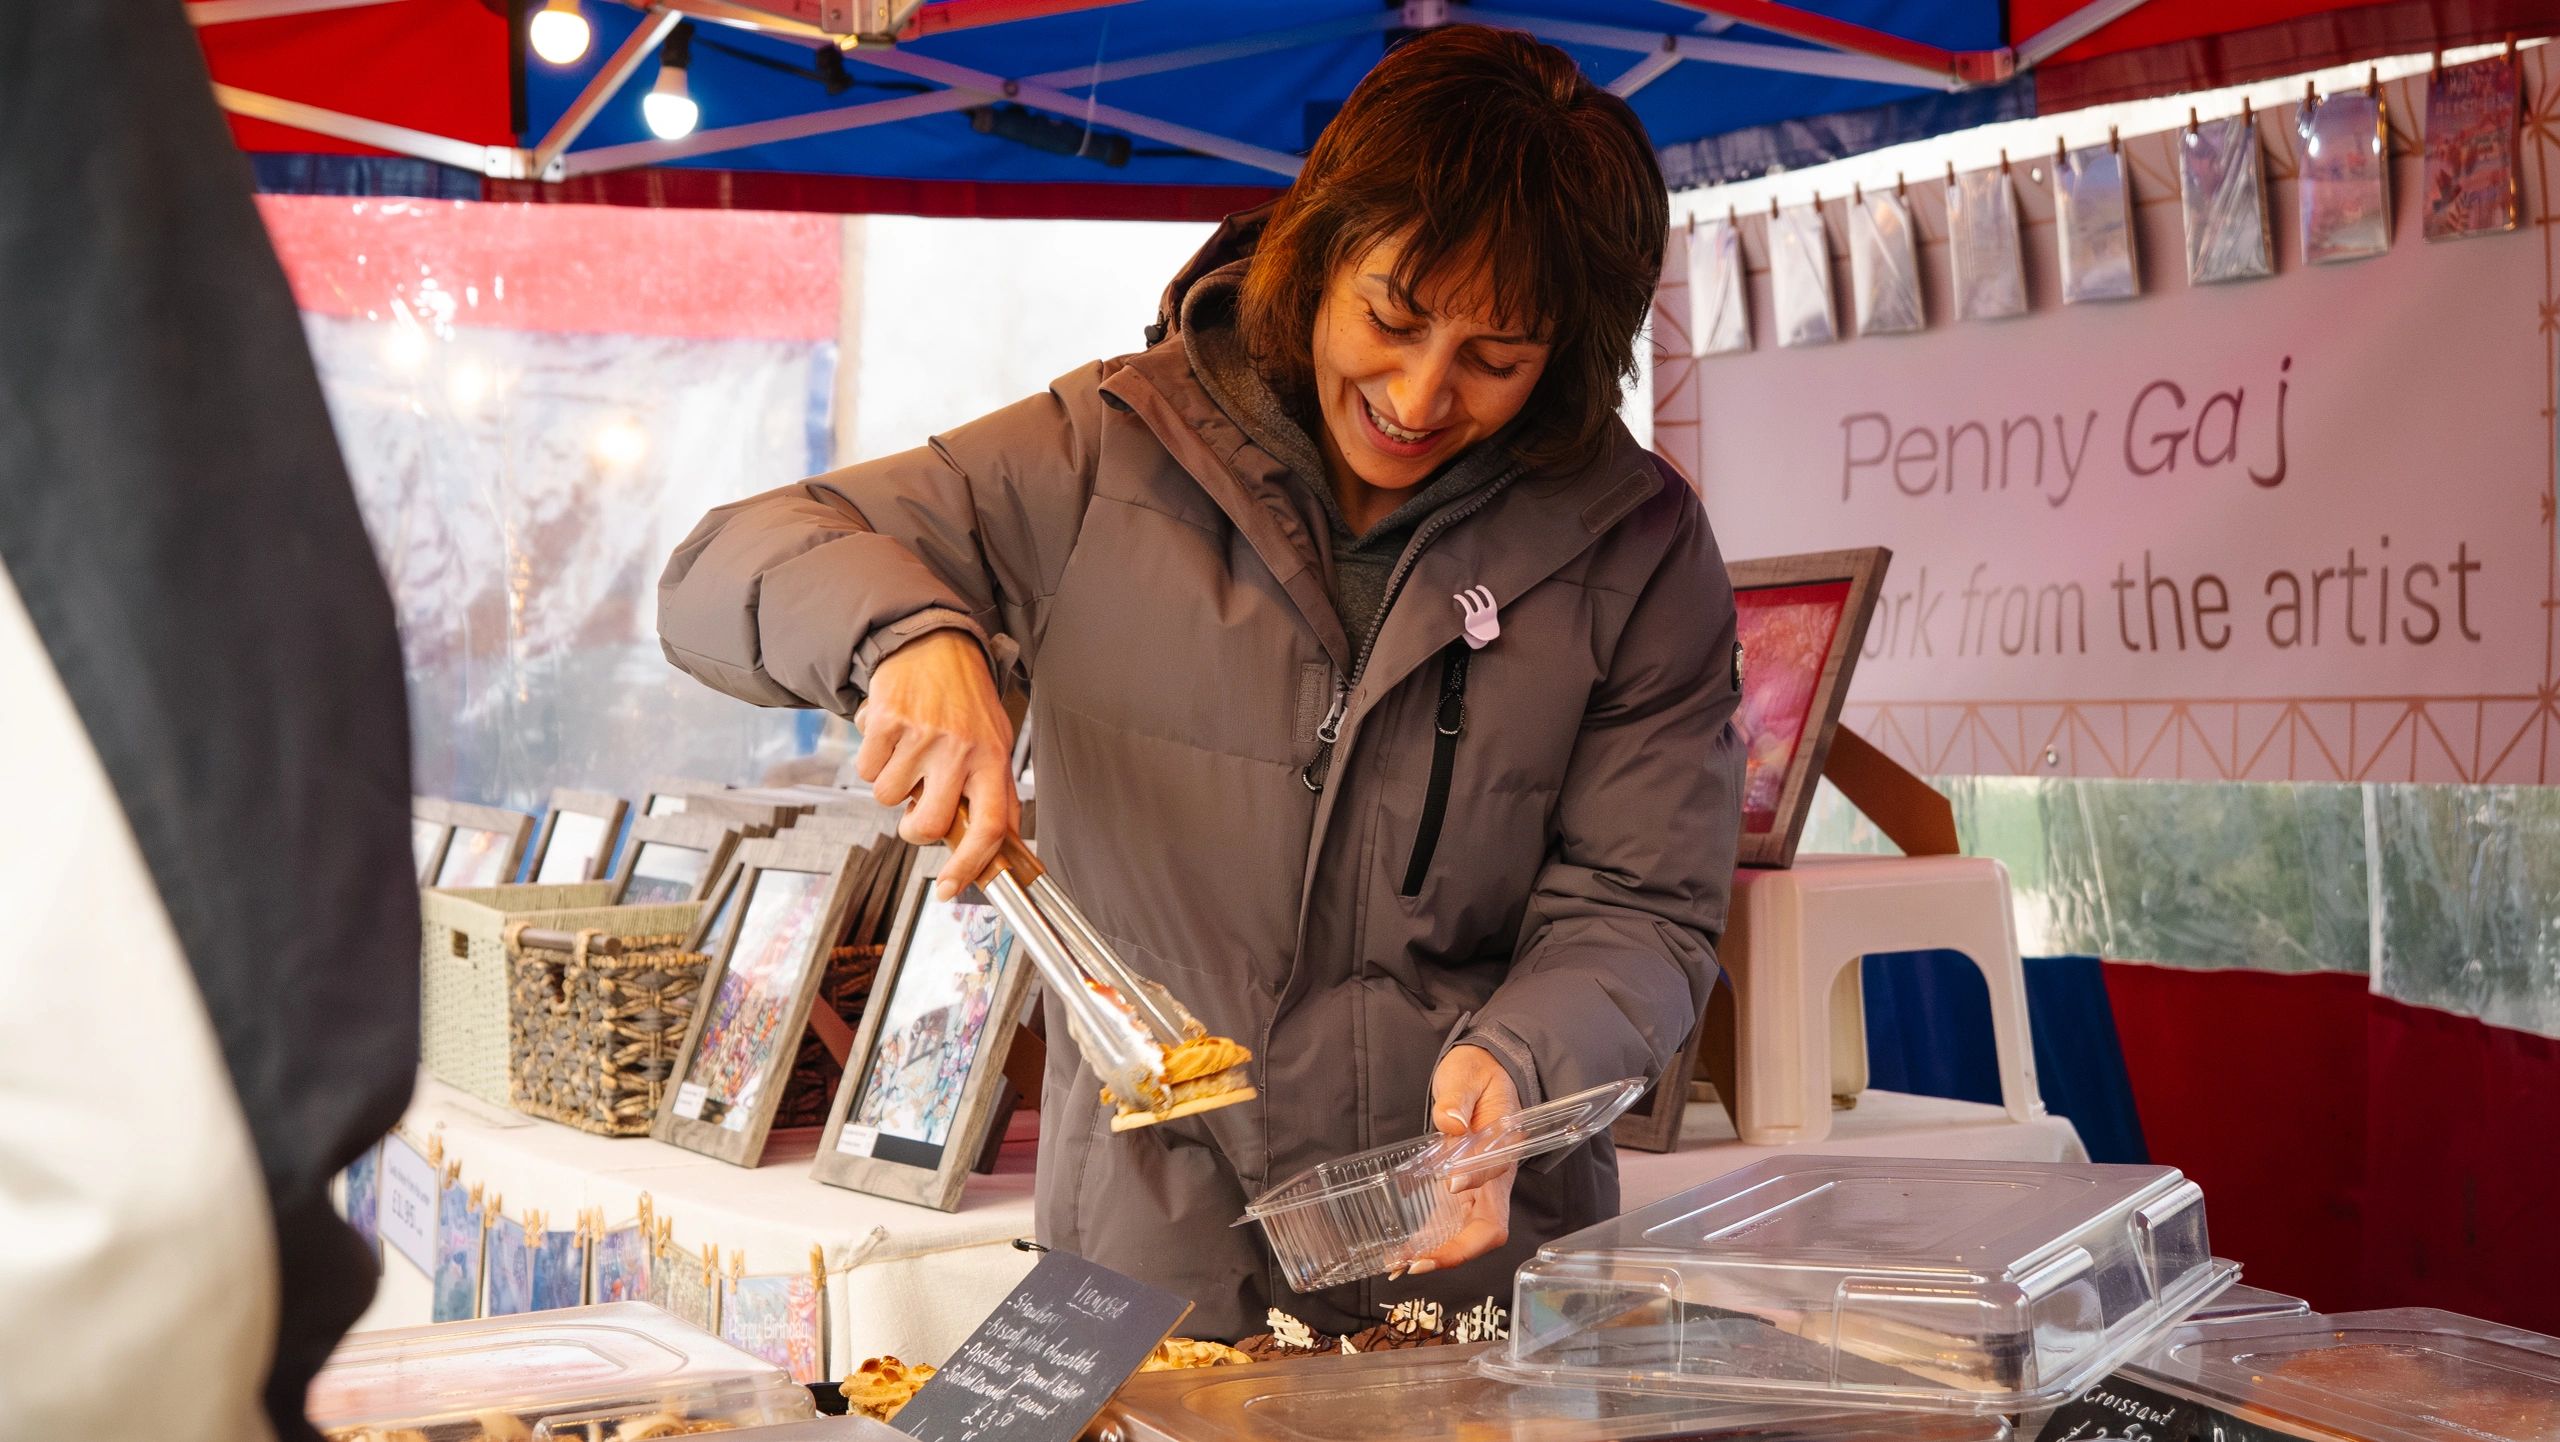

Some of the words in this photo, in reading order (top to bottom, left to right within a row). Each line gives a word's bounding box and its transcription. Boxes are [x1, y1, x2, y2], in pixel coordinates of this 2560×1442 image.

[1840, 410, 2099, 508] Penny
[2123, 355, 2293, 490] Gaj
[1861, 565, 1944, 660] ork
[1956, 562, 2087, 658] from
[2111, 549, 2232, 652] the
[2264, 535, 2483, 648] artist
[2083, 1384, 2176, 1426] Croissant
